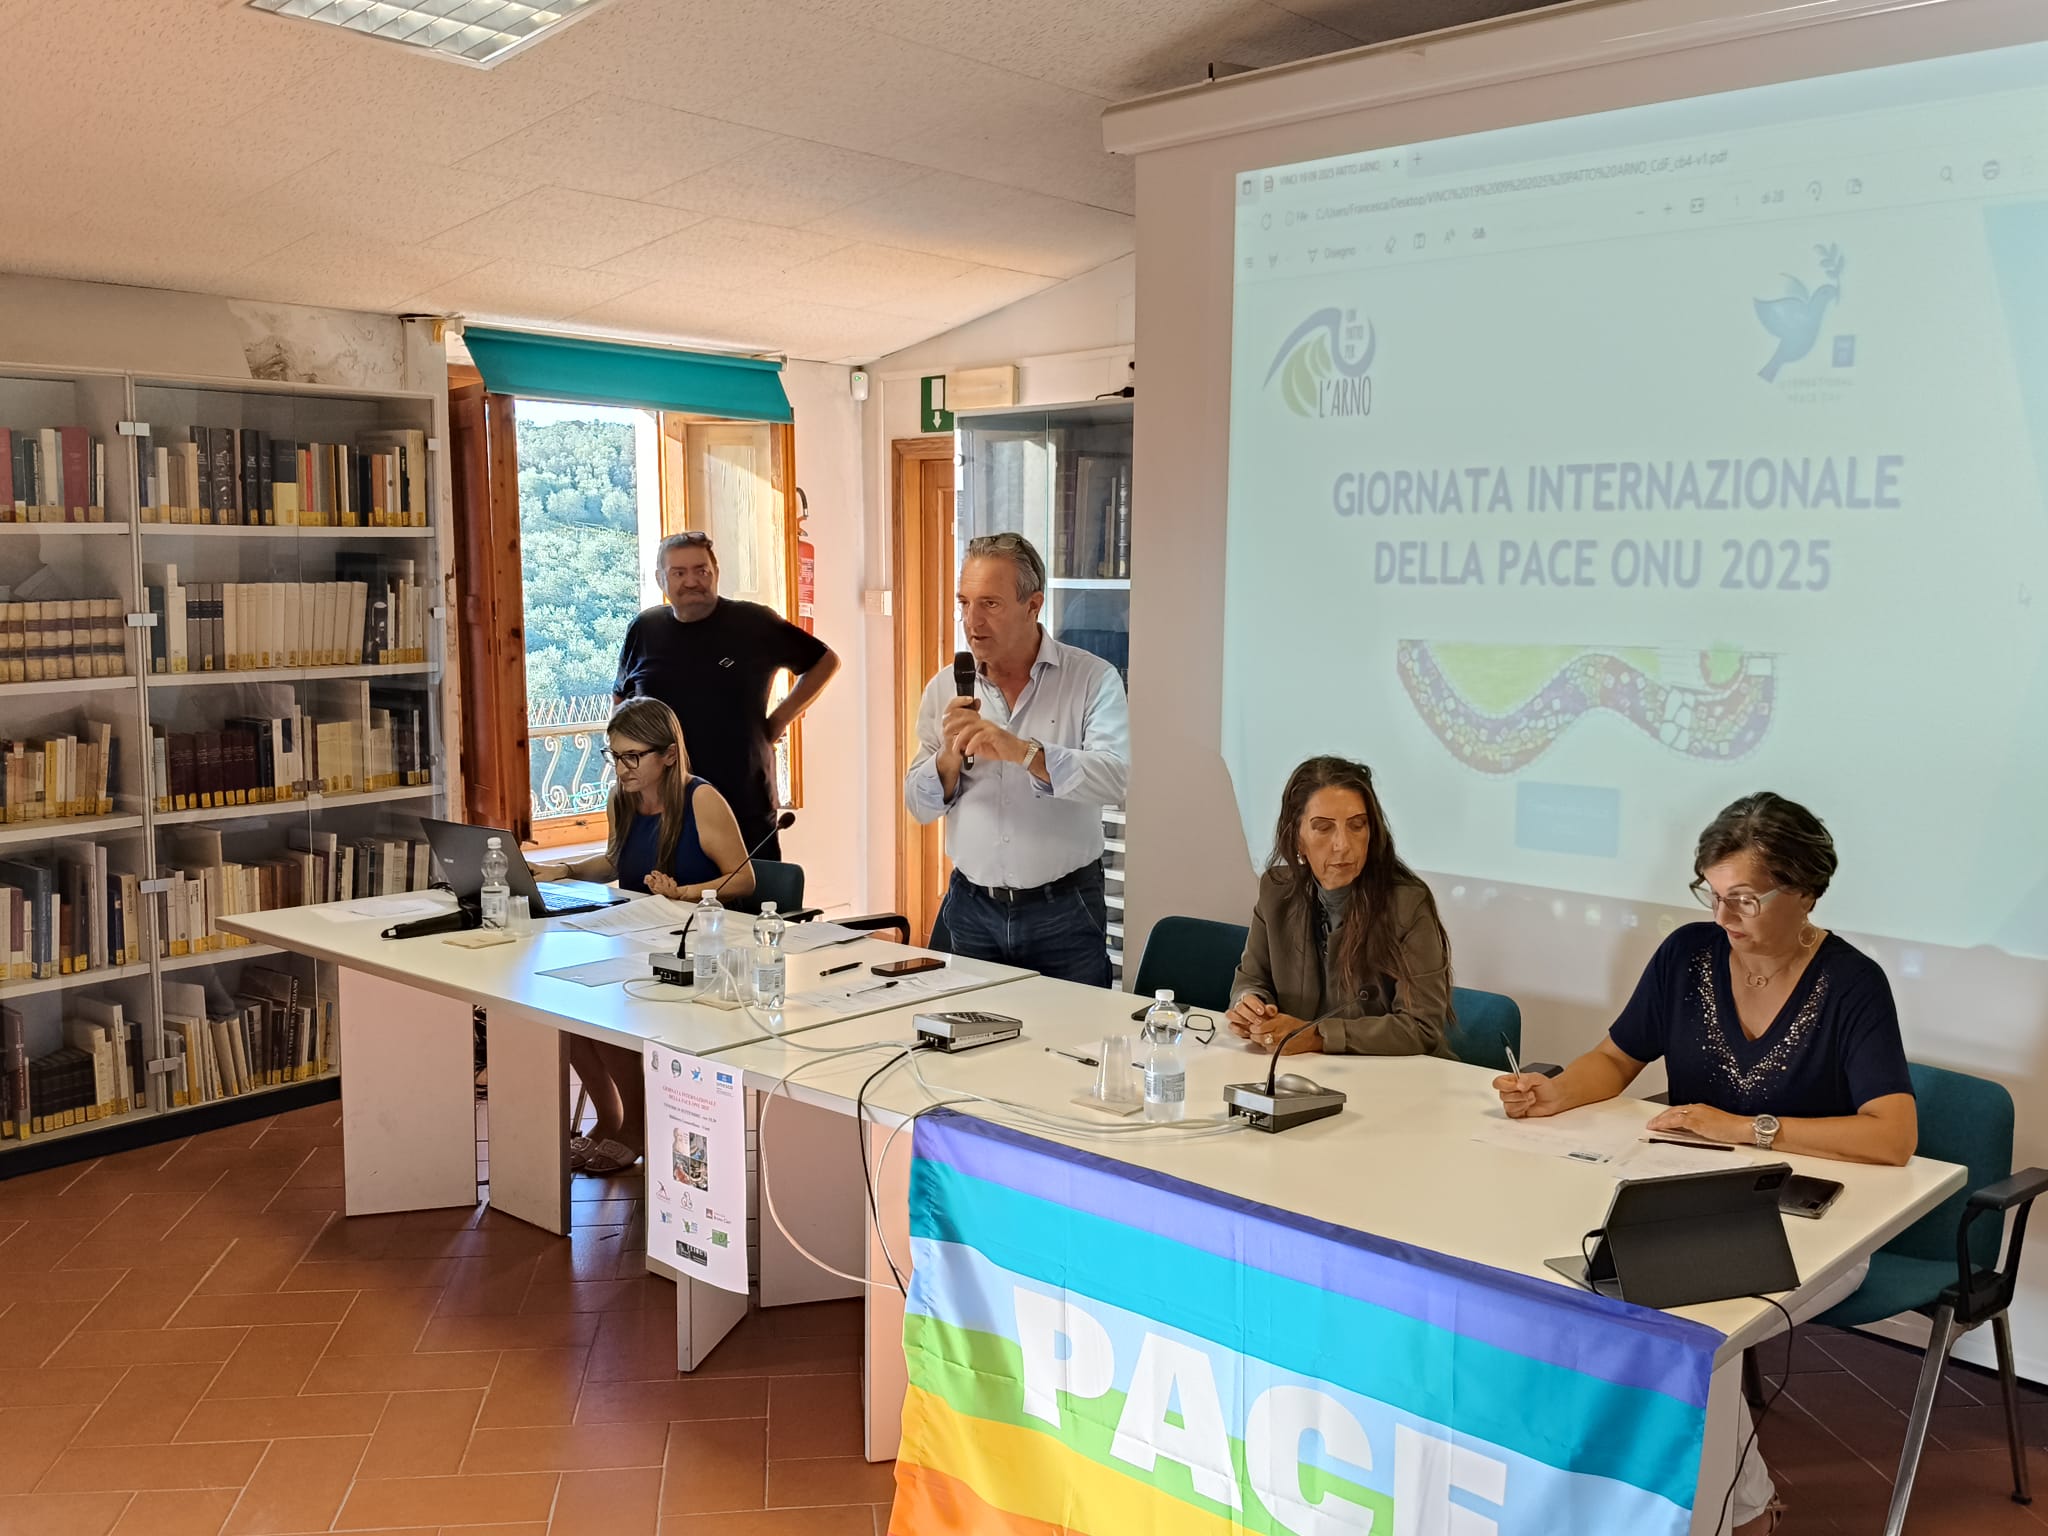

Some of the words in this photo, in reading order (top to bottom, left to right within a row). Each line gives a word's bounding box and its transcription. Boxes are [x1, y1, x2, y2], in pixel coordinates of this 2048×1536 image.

[1319, 376, 1372, 418] L'ARNO
[1333, 466, 1513, 517] GIORNATA
[1527, 455, 1905, 513] INTERNAZIONALE
[1374, 540, 1485, 585] DELLA
[1498, 539, 1599, 587] PACE
[1611, 539, 1702, 588] ONU
[1718, 538, 1832, 592] 2025
